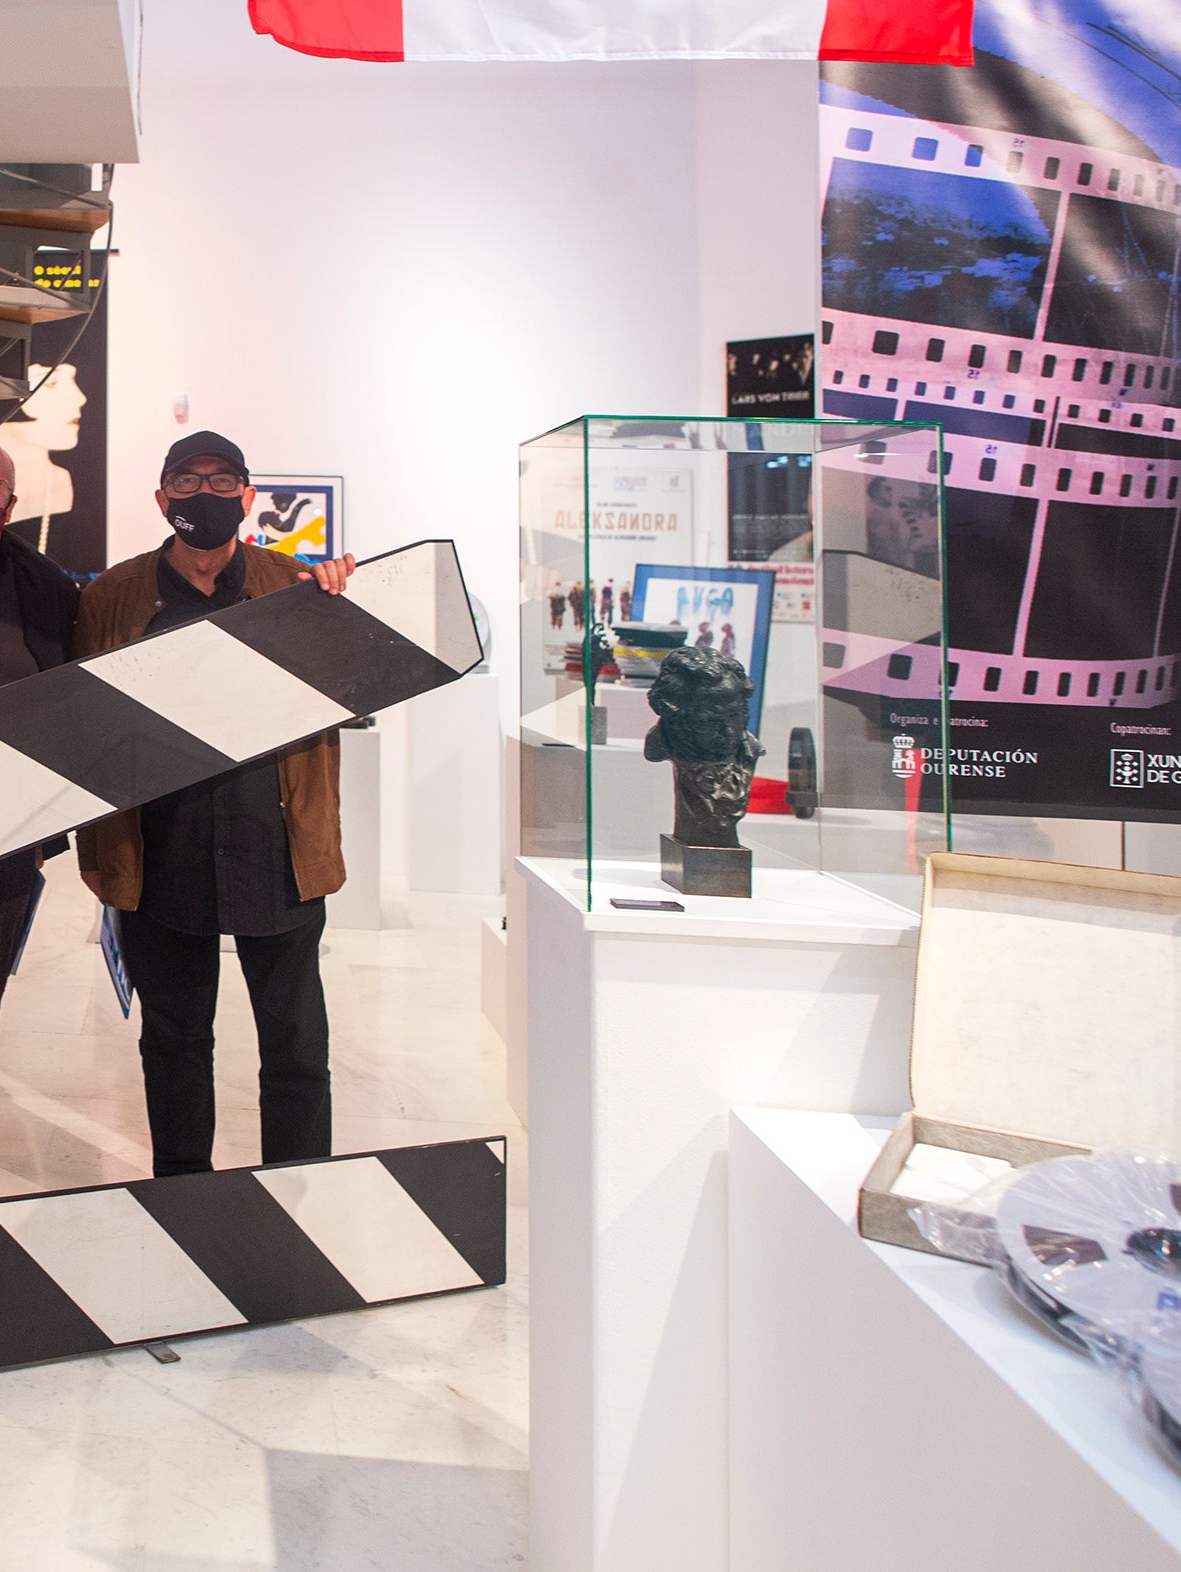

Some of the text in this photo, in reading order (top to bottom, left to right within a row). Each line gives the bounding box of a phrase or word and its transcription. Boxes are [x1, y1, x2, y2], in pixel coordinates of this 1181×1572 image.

[34, 265, 44, 275] O
[731, 393, 756, 405] LARS
[757, 392, 780, 403] VON
[889, 712, 929, 727] Organiza
[950, 716, 989, 728] atrocina:
[920, 747, 1038, 764] DEPUTACIÓN
[920, 761, 1006, 778] OURENSE
[1146, 769, 1170, 783] DE
